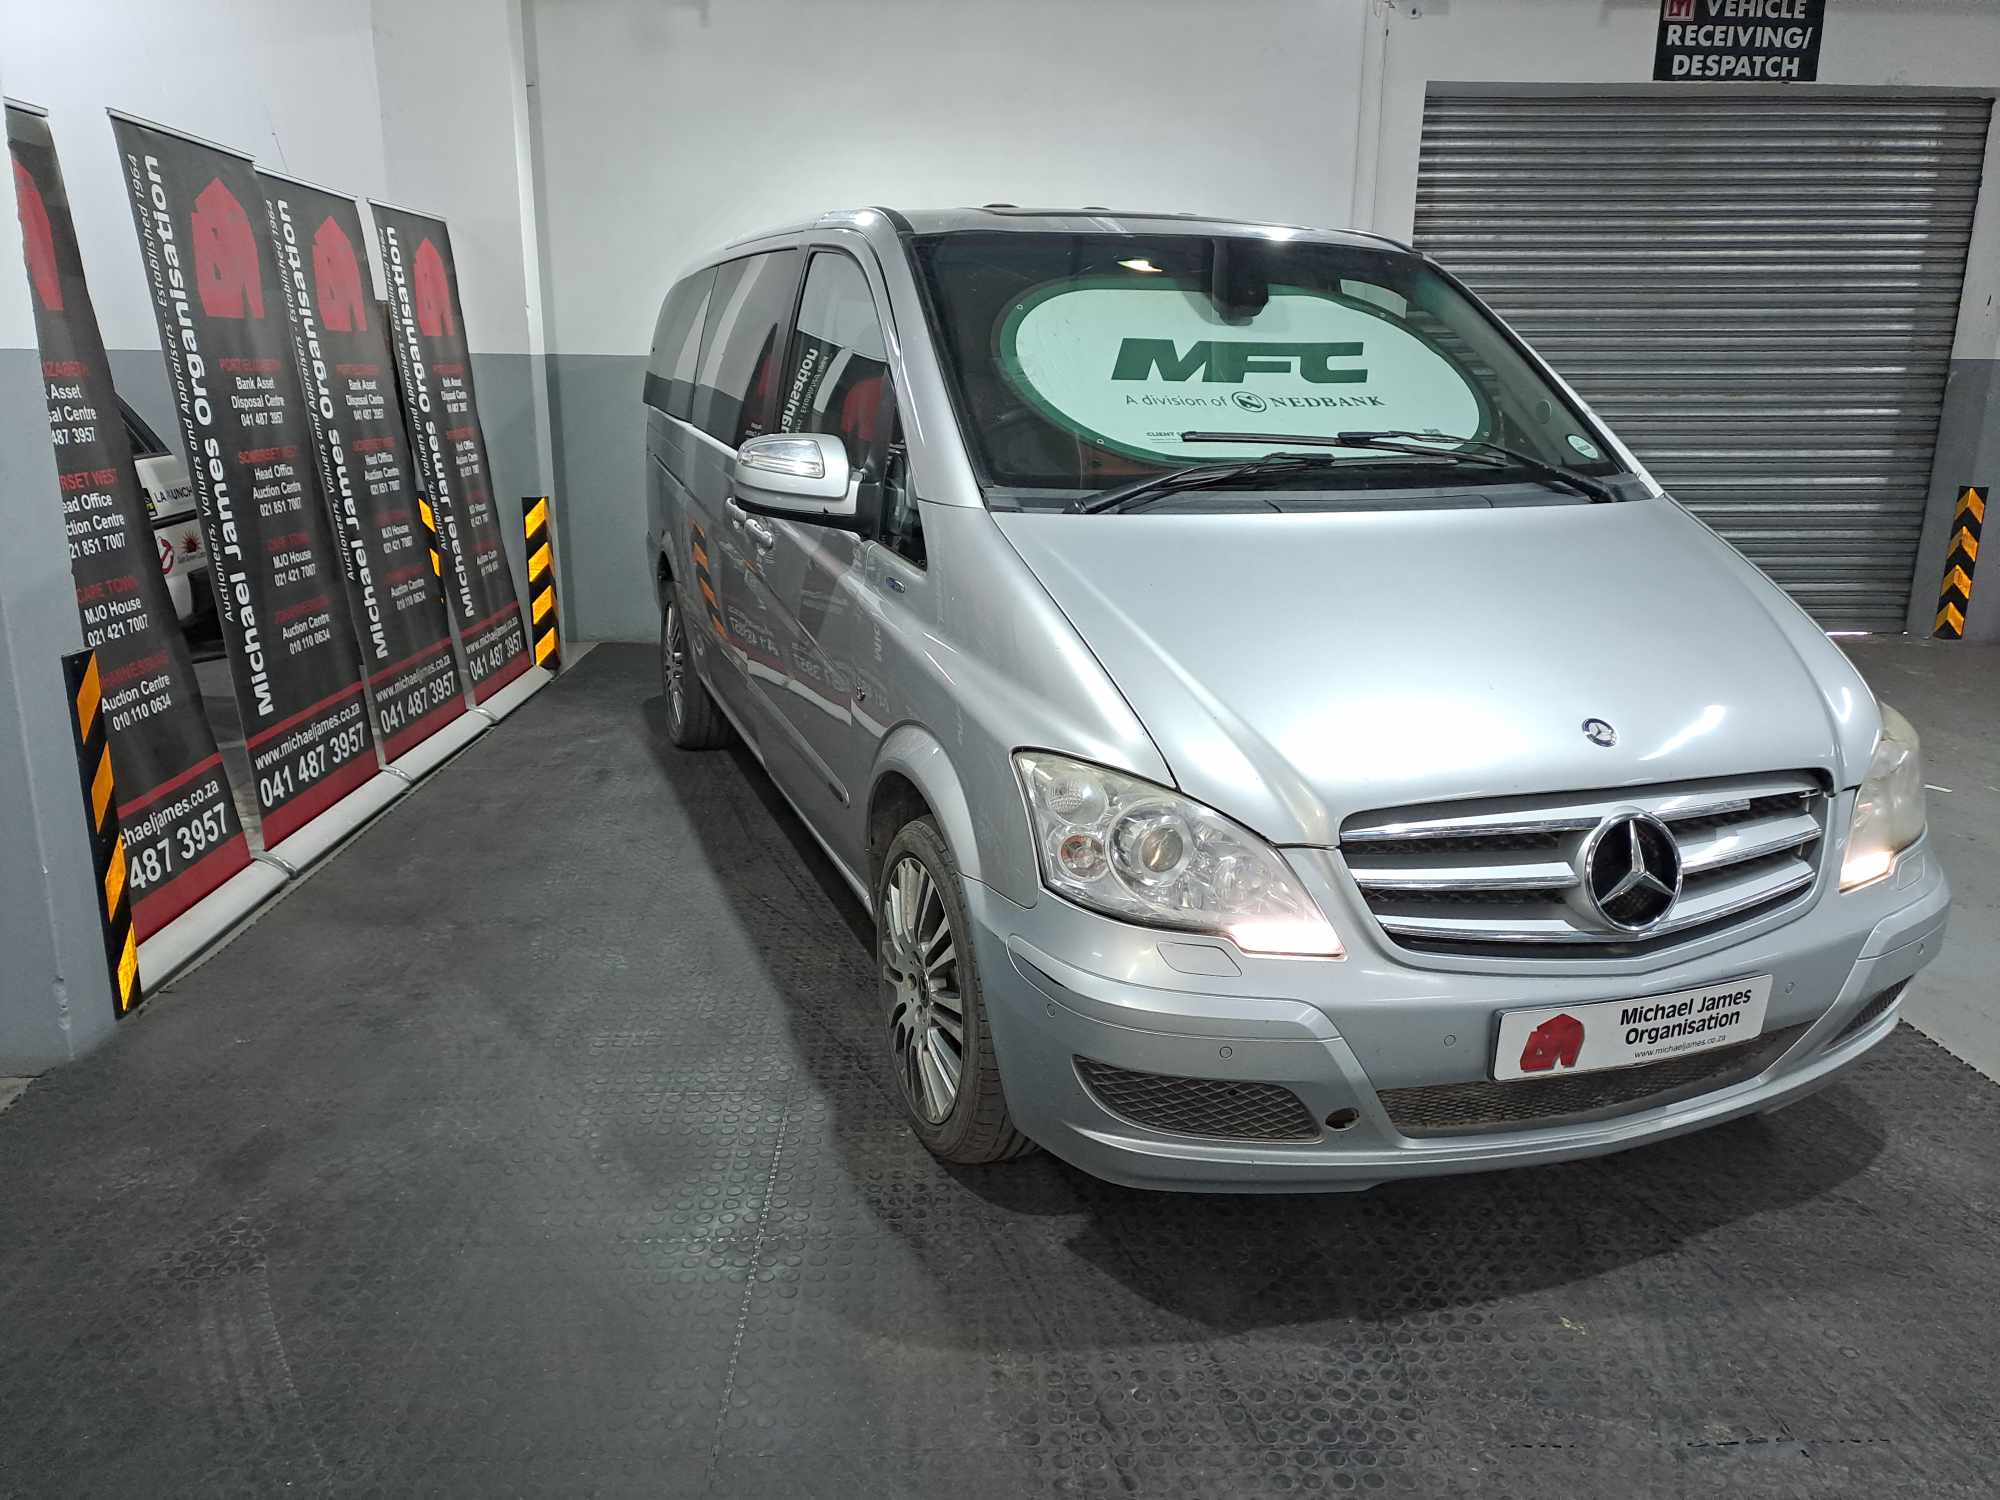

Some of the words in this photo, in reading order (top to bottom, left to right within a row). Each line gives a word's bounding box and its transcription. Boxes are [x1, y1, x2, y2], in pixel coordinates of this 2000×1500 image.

[1707, 0, 1806, 19] VEHICLE
[1666, 24, 1813, 49] RECEIVING/
[1671, 54, 1800, 78] DESPATCH
[127, 153, 144, 198] 1964
[139, 199, 168, 308] Established
[144, 155, 212, 426] Organisation
[273, 240, 298, 323] Established
[277, 199, 334, 419] Organisation
[386, 226, 432, 413] Organisation
[165, 323, 191, 415] Appraisers
[1111, 337, 1368, 384] MFC
[50, 384, 83, 400] Asset
[231, 395, 264, 411] Disposal
[1125, 393, 1139, 406] A
[1142, 393, 1207, 407] division
[1210, 393, 1228, 408] of
[1270, 395, 1387, 409] NEDBANK
[64, 405, 97, 421] Centre
[310, 412, 323, 440] and
[74, 427, 96, 443] 3957
[183, 418, 198, 449] and
[255, 466, 273, 480] Head
[318, 443, 335, 493] Valuers
[328, 429, 360, 531] James
[425, 420, 452, 509] James
[81, 493, 113, 510] Office
[193, 456, 212, 516] Valuers
[204, 437, 241, 561] James
[253, 485, 281, 501] Auction
[66, 519, 91, 536] ction
[93, 513, 125, 530] Centre
[260, 503, 273, 517] 021
[82, 538, 101, 556] 851
[103, 533, 126, 550] 7007
[272, 553, 290, 569] MJO
[207, 523, 234, 622] Auctioneers,
[444, 515, 476, 618] Michael
[84, 604, 107, 625] MJO
[109, 597, 142, 617] House
[351, 539, 388, 659] Michael
[87, 630, 106, 647] 021
[107, 622, 126, 640] 421
[127, 614, 149, 633] 7007
[229, 571, 274, 717] Michael
[282, 621, 308, 640] Auction
[470, 654, 489, 681] 041
[489, 643, 504, 669] 487
[505, 630, 523, 658] 3957
[101, 687, 140, 714] Auction
[140, 673, 171, 697] Centre
[112, 713, 131, 731] 010
[130, 706, 149, 724] 110
[150, 693, 173, 714] 0634
[380, 701, 406, 733] 041
[407, 686, 427, 718] 487
[429, 671, 456, 704] 3957
[255, 702, 361, 770] www.michaeljames.co.za
[260, 765, 294, 808] 041
[298, 744, 327, 783] 487
[330, 721, 365, 764] 3957
[129, 838, 173, 889] 487
[176, 801, 229, 860] 3957
[1620, 998, 1694, 1026] Michael
[1696, 988, 1752, 1015] James
[1625, 1010, 1741, 1046] Organisation
[1634, 1034, 1726, 1058] www.michaeljames.co.za
